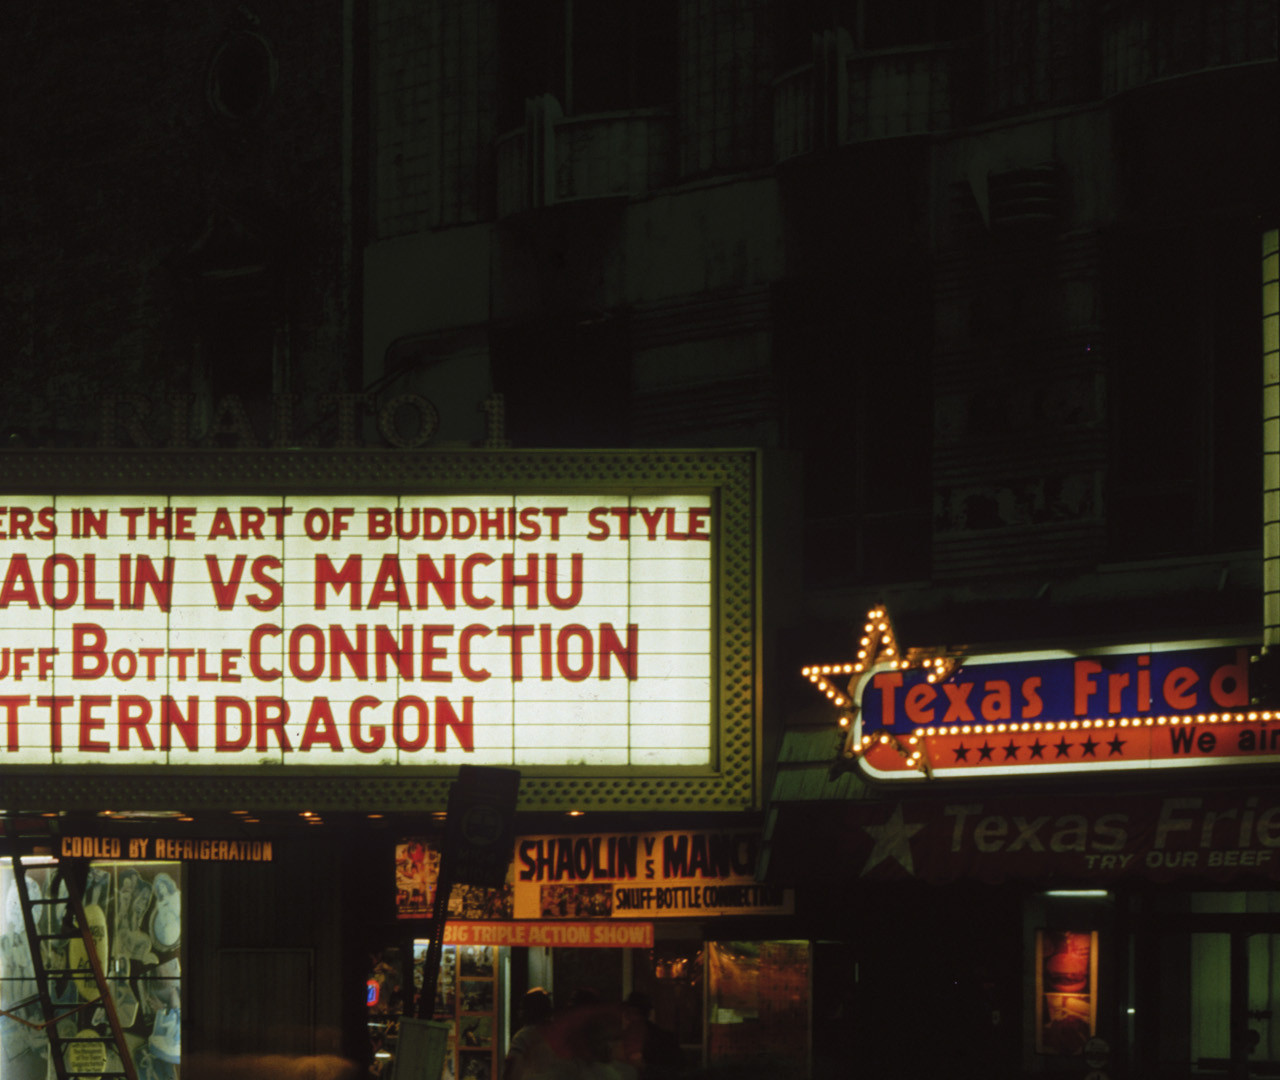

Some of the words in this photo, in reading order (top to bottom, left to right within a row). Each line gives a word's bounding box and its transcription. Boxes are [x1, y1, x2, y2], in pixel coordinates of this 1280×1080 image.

[71, 506, 107, 540] IN
[121, 506, 196, 541] THE
[208, 506, 292, 541] ART
[304, 506, 355, 541] OF
[366, 506, 564, 541] BUDDHIST
[586, 506, 712, 541] STYLE
[205, 554, 283, 611] VS
[313, 553, 585, 611] MANCHU
[248, 622, 640, 682] CONNECTION
[874, 671, 1044, 725] Texas
[1074, 648, 1250, 716] Fried
[214, 694, 475, 753] DRAGON
[1170, 727, 1216, 754] We
[61, 837, 122, 858] COOLED
[129, 839, 148, 857] BY
[155, 839, 273, 861] REFRIGERATION
[944, 803, 1129, 853] Texas
[518, 836, 638, 881] SHAOLIN
[1085, 854, 1133, 870] TRY
[1146, 851, 1199, 868] OUR
[1207, 850, 1273, 867] BEEF
[443, 924, 468, 942] BIG
[472, 925, 526, 943] TRIPLE
[528, 925, 591, 944] ACTION
[593, 926, 652, 945] SHOW!
